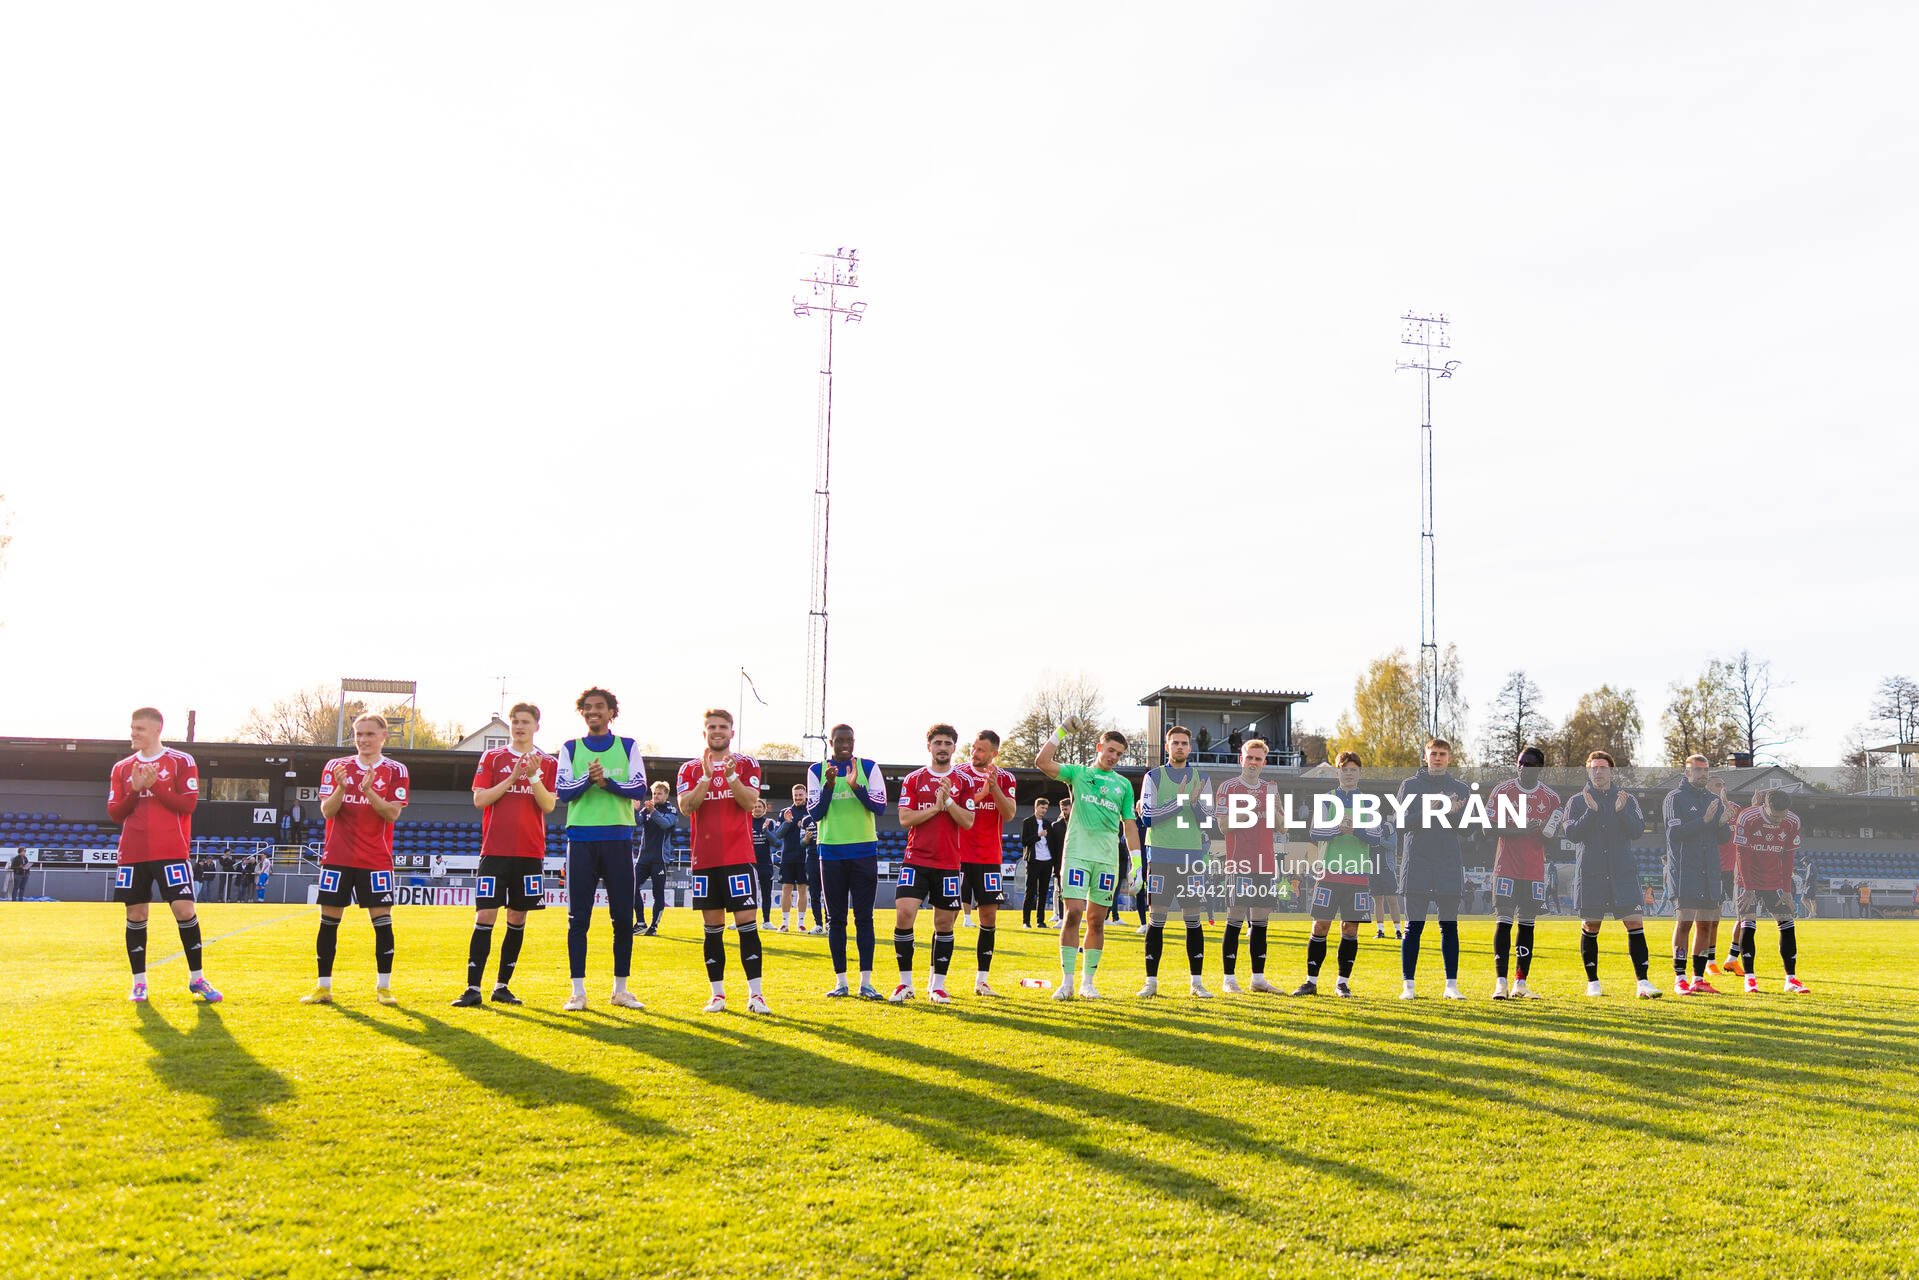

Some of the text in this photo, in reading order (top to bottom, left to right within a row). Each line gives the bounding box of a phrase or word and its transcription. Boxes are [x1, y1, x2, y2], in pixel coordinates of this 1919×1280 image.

[300, 789, 310, 799] B
[1081, 793, 1119, 812] HOLMEN
[262, 811, 273, 822] A
